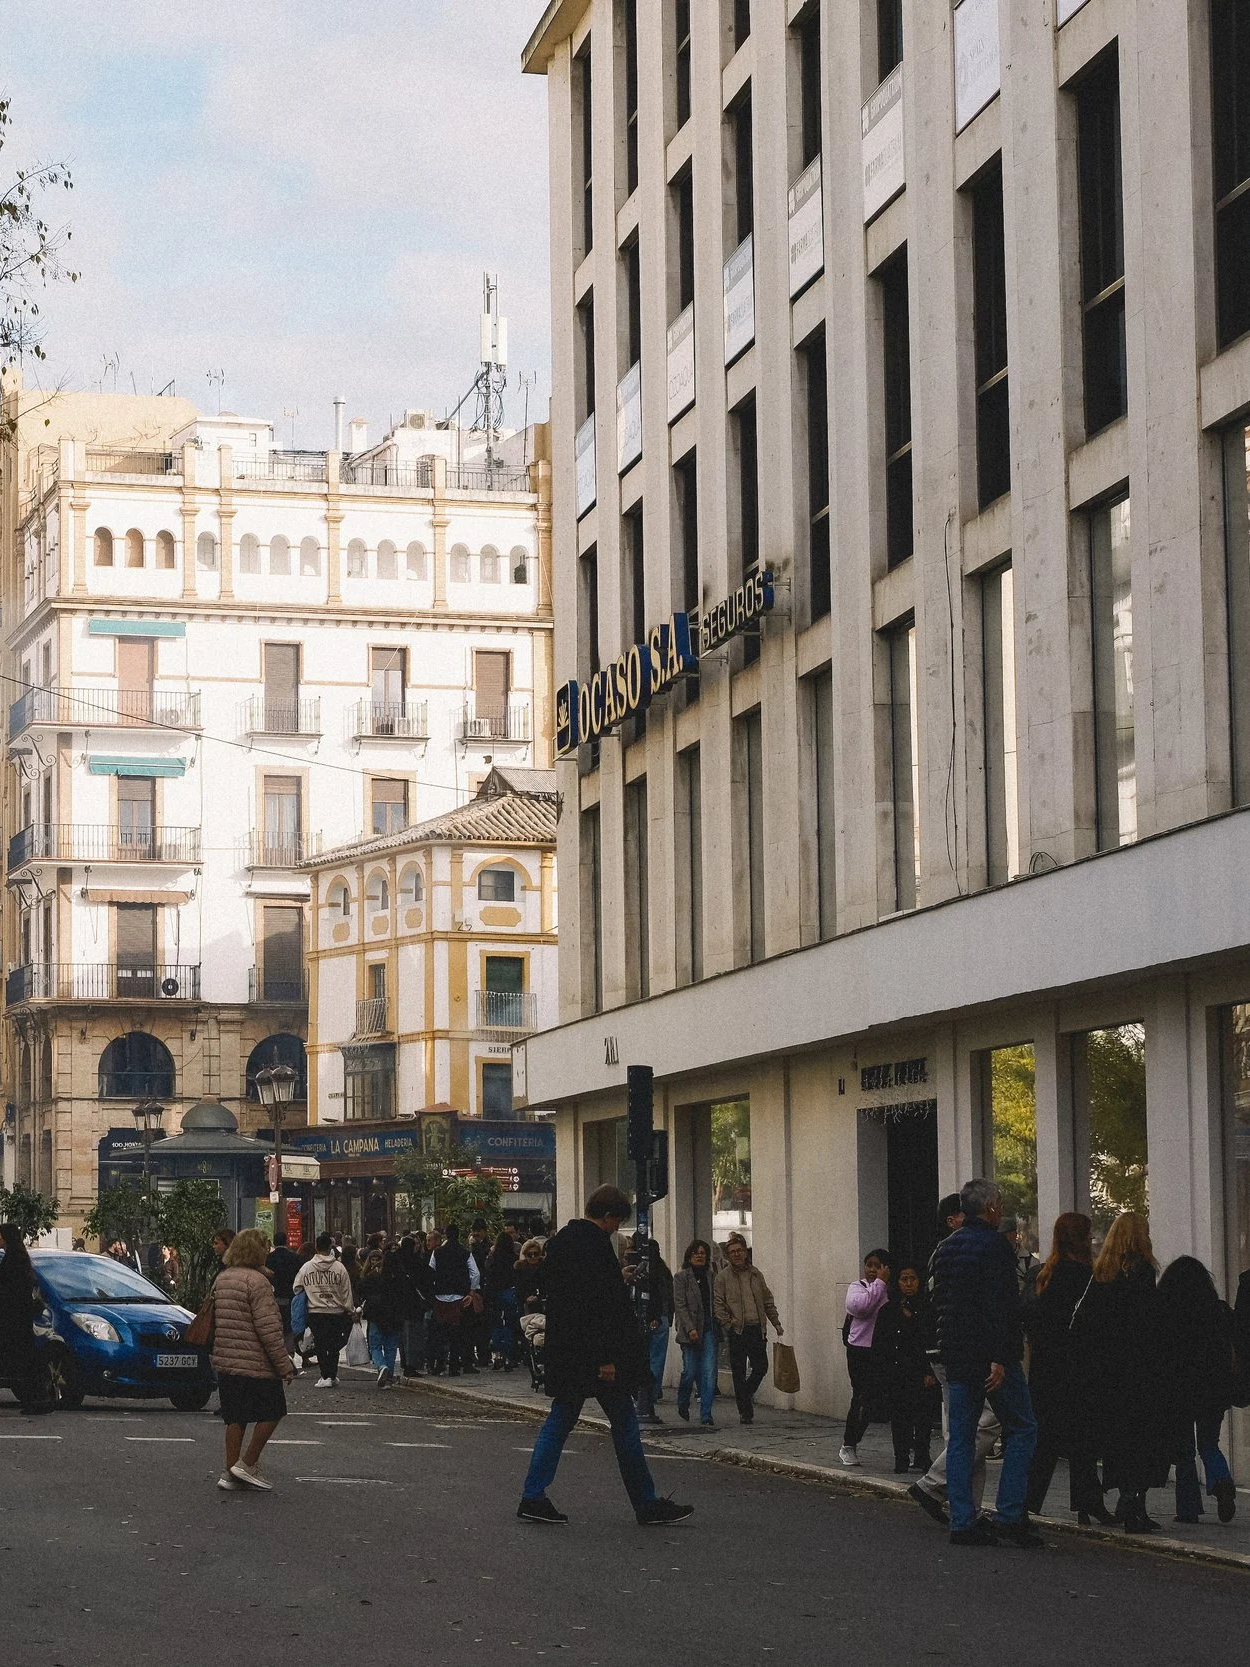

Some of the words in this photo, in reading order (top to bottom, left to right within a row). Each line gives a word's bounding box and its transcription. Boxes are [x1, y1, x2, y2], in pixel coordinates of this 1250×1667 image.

[579, 643, 643, 743] OCASO
[650, 614, 687, 695] S.A.
[702, 571, 766, 650] SEGUROS
[330, 1140, 340, 1154] LA
[343, 1137, 379, 1154] CAMPANA
[384, 1137, 412, 1149] HELADERIA
[304, 1271, 315, 1286] OUT
[316, 1270, 324, 1285] OF
[158, 1356, 179, 1366] 5237
